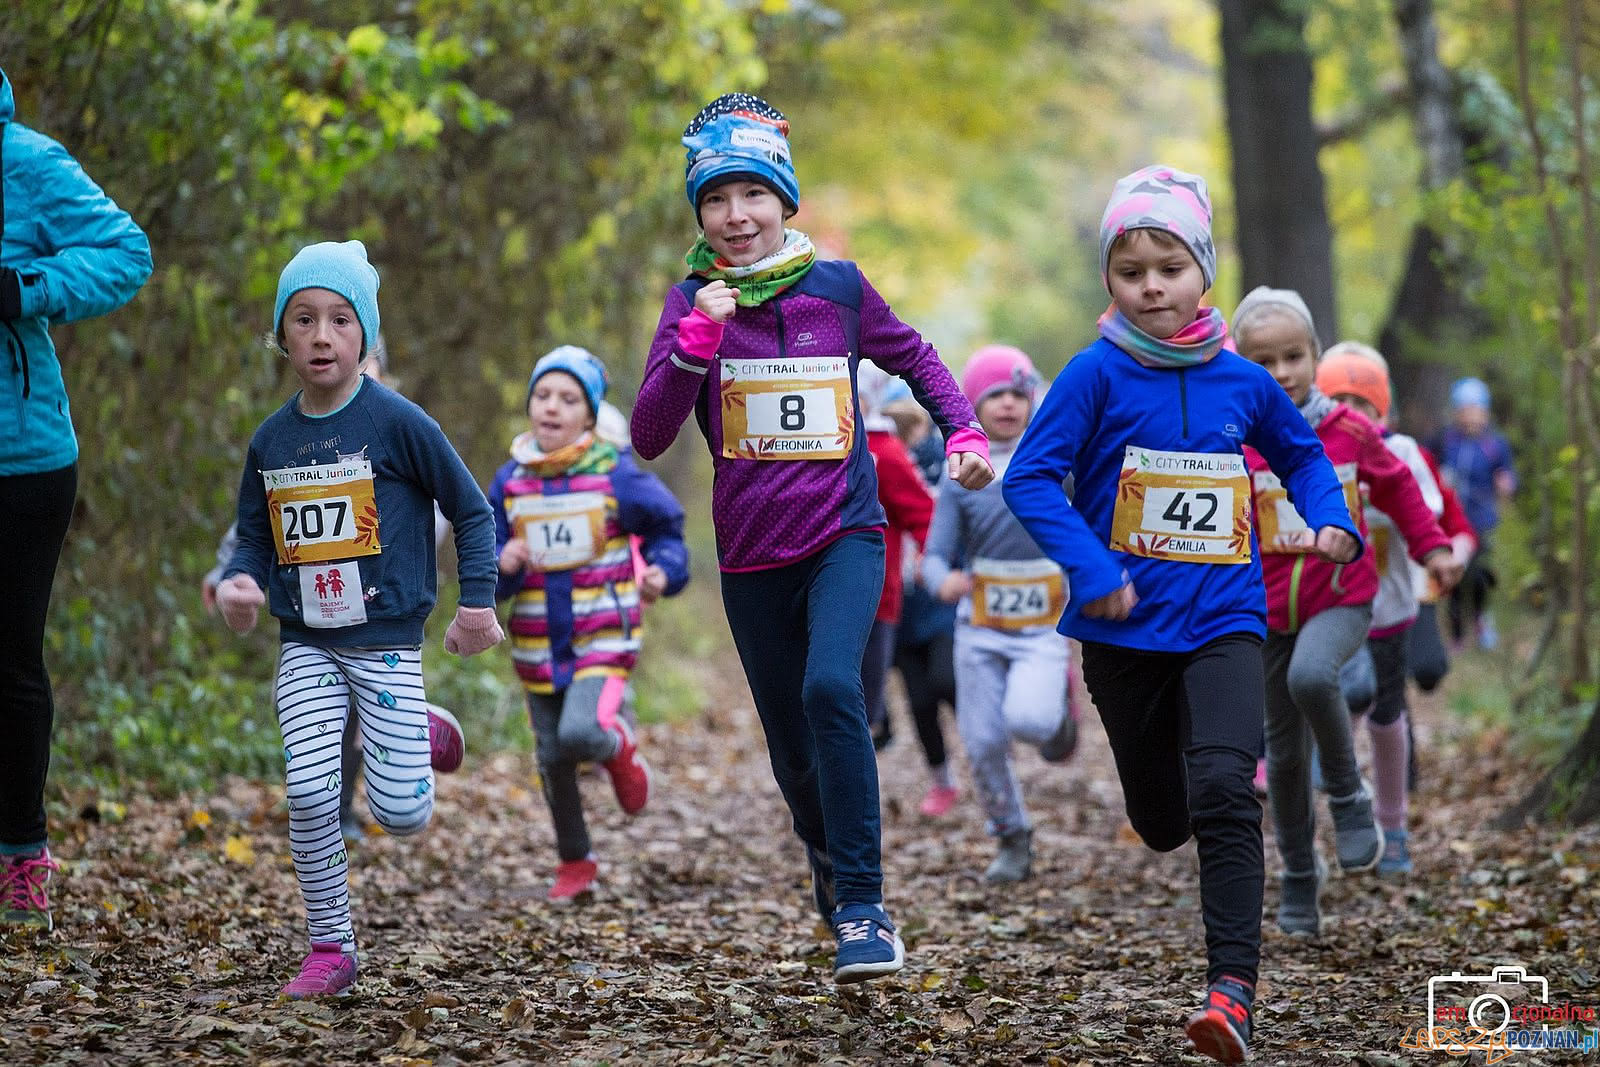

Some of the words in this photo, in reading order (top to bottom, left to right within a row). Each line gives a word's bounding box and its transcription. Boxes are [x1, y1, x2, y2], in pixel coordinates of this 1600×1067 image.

[802, 364, 830, 373] Junior
[780, 395, 806, 431] 8
[326, 468, 358, 479] Junior
[1216, 460, 1241, 471] Junior
[283, 501, 348, 541] 207
[1162, 492, 1218, 532] 42
[541, 522, 572, 548] 14
[1168, 539, 1206, 552] EMILIA
[990, 586, 1043, 612] 224
